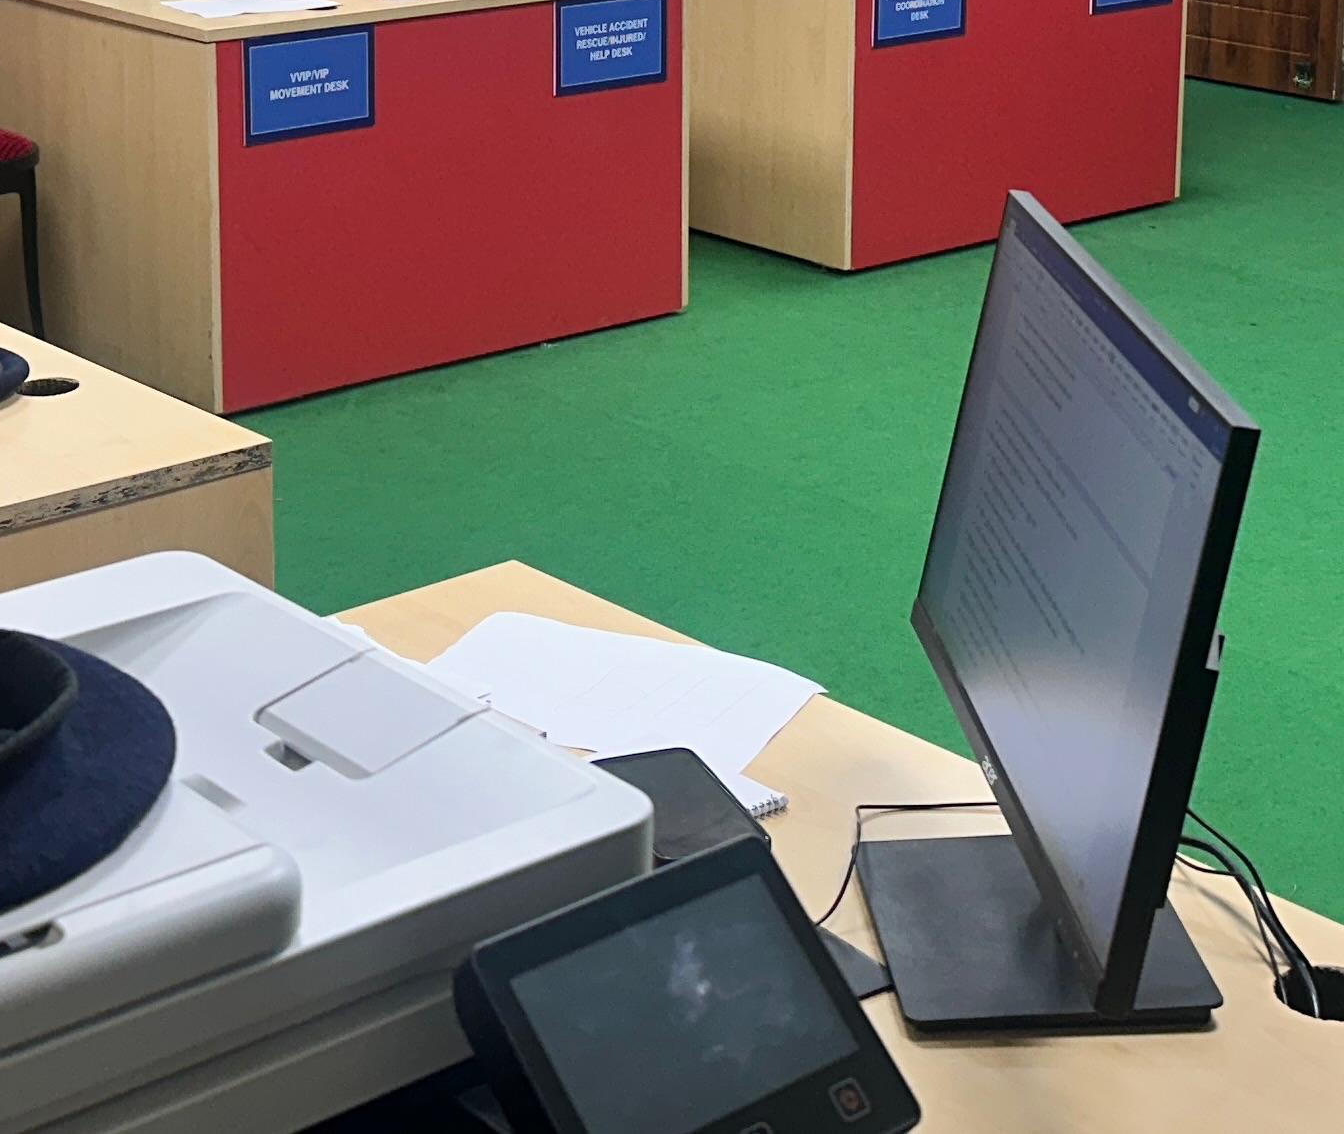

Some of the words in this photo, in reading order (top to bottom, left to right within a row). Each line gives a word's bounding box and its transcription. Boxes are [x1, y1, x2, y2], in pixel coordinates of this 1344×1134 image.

[574, 23, 607, 37] VEHICLE
[609, 18, 648, 32] ACCIDENT
[590, 50, 610, 61] HELP
[611, 46, 633, 58] DESK
[290, 68, 329, 83] VVIP/VIP
[270, 83, 322, 101] MOVEMENT
[324, 80, 349, 92] DESK
